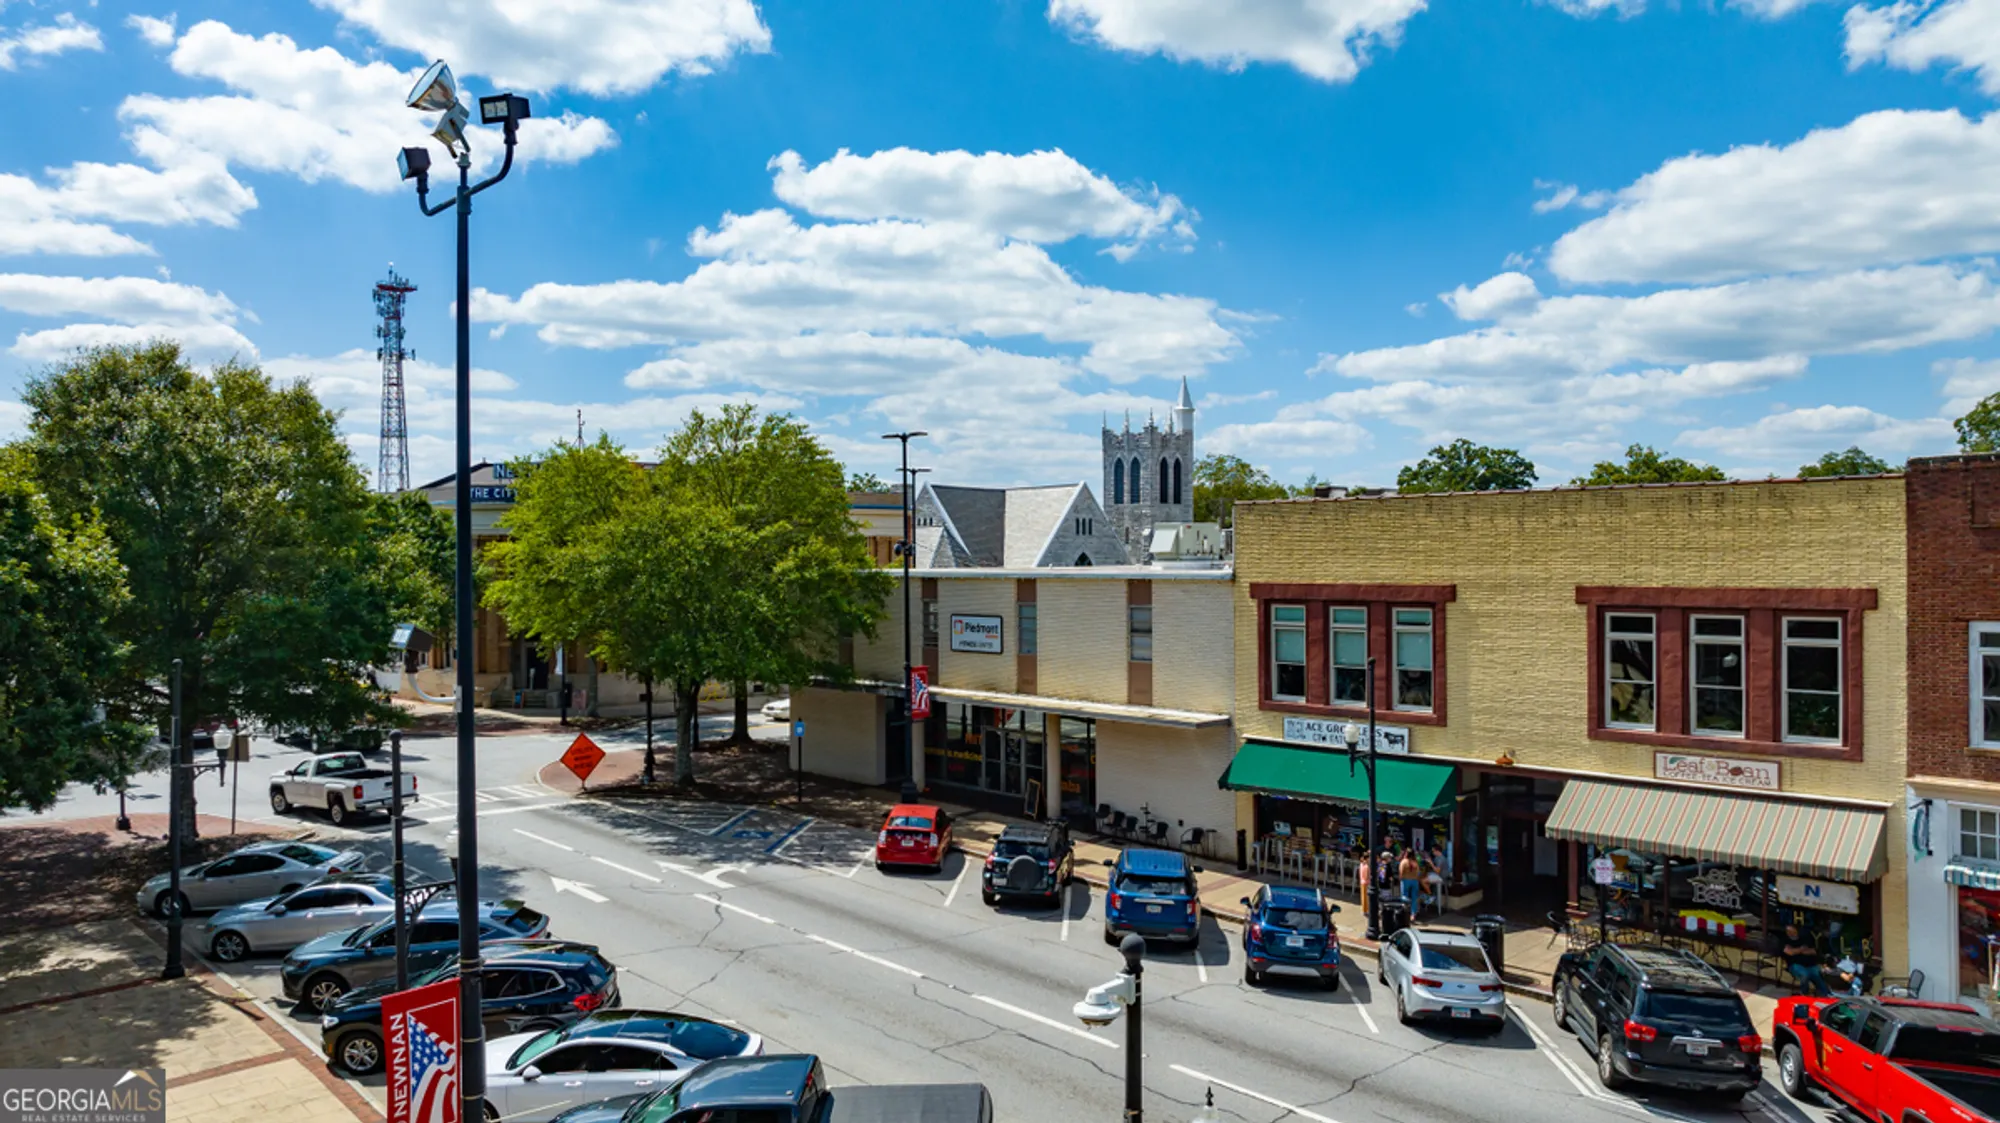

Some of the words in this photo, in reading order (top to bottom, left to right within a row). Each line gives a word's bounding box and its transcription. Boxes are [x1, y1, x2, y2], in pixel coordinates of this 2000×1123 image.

[470, 488, 489, 498] THE
[965, 622, 999, 634] Piedmont
[1305, 721, 1323, 732] ACE
[1326, 723, 1383, 738] GROLES
[1663, 756, 1704, 774] Leaf
[1691, 882, 1743, 910] Bean
[1804, 884, 1820, 897] N
[389, 1012, 408, 1118] NEWNAN
